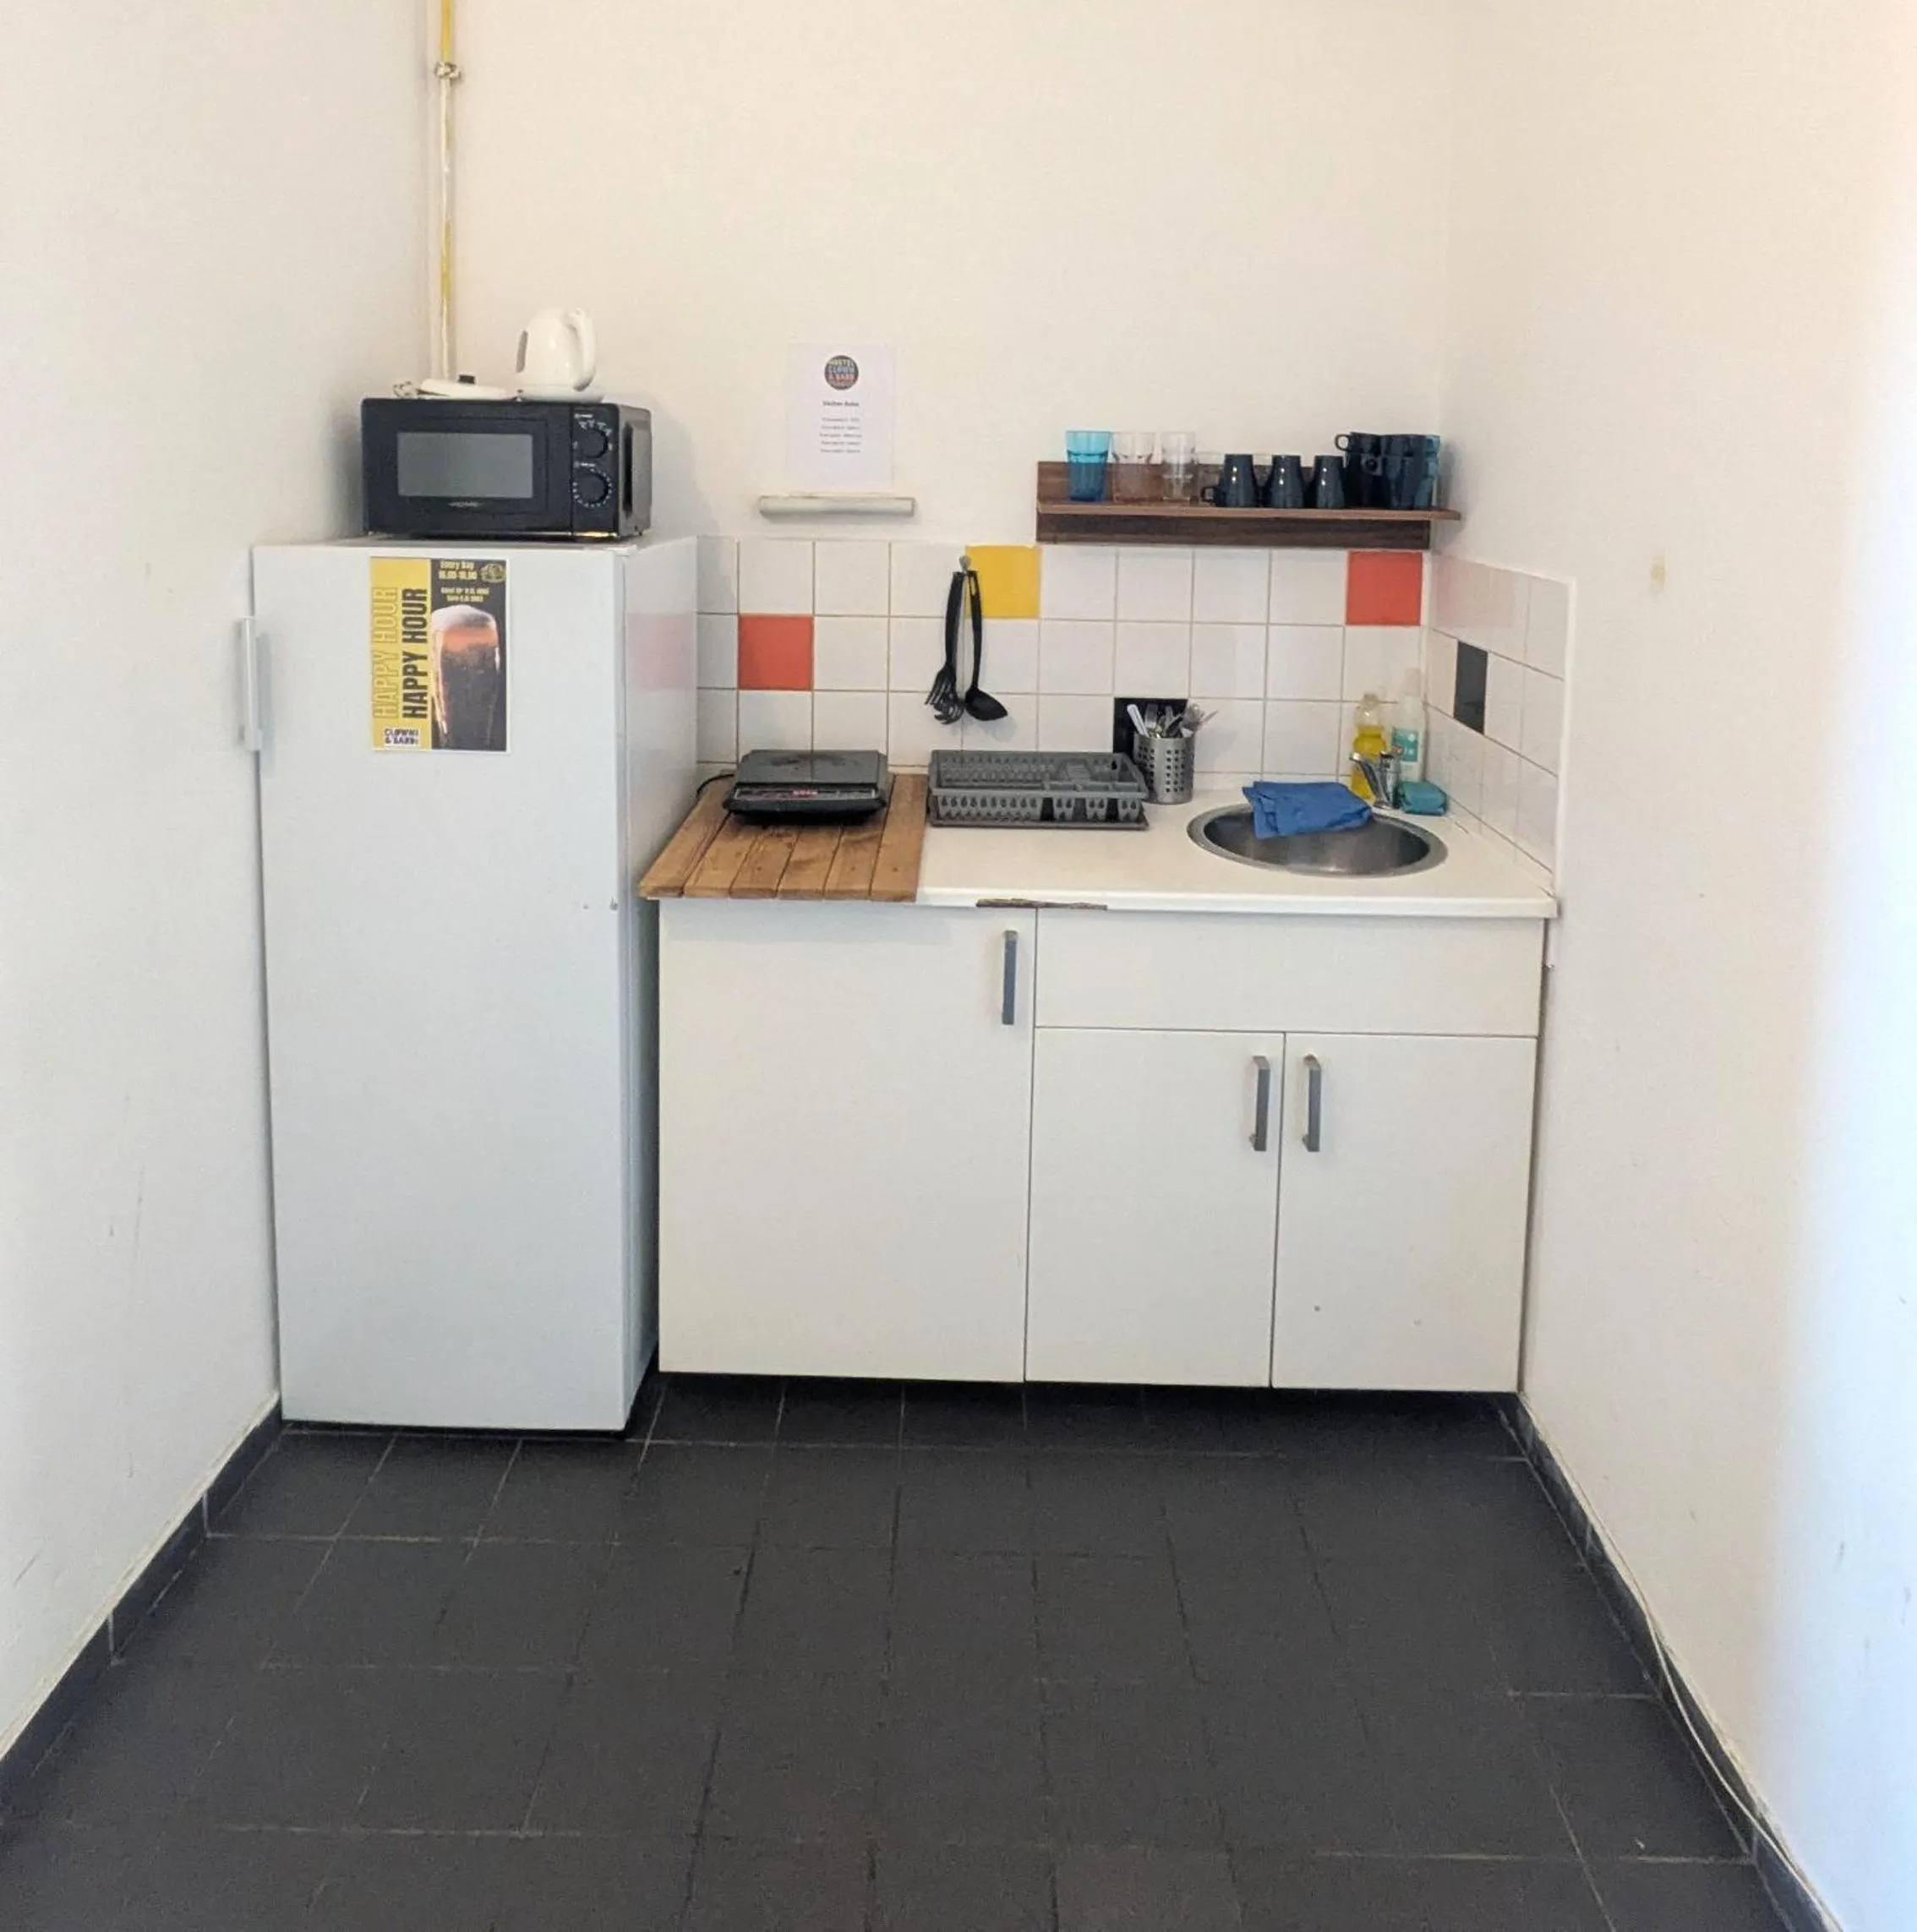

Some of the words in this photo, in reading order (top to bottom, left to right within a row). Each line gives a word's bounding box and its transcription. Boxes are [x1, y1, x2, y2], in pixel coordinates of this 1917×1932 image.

[372, 587, 398, 643] HOUR
[401, 588, 428, 643] HOUR
[372, 649, 398, 718] HAPPY
[401, 650, 428, 718] HAPPY
